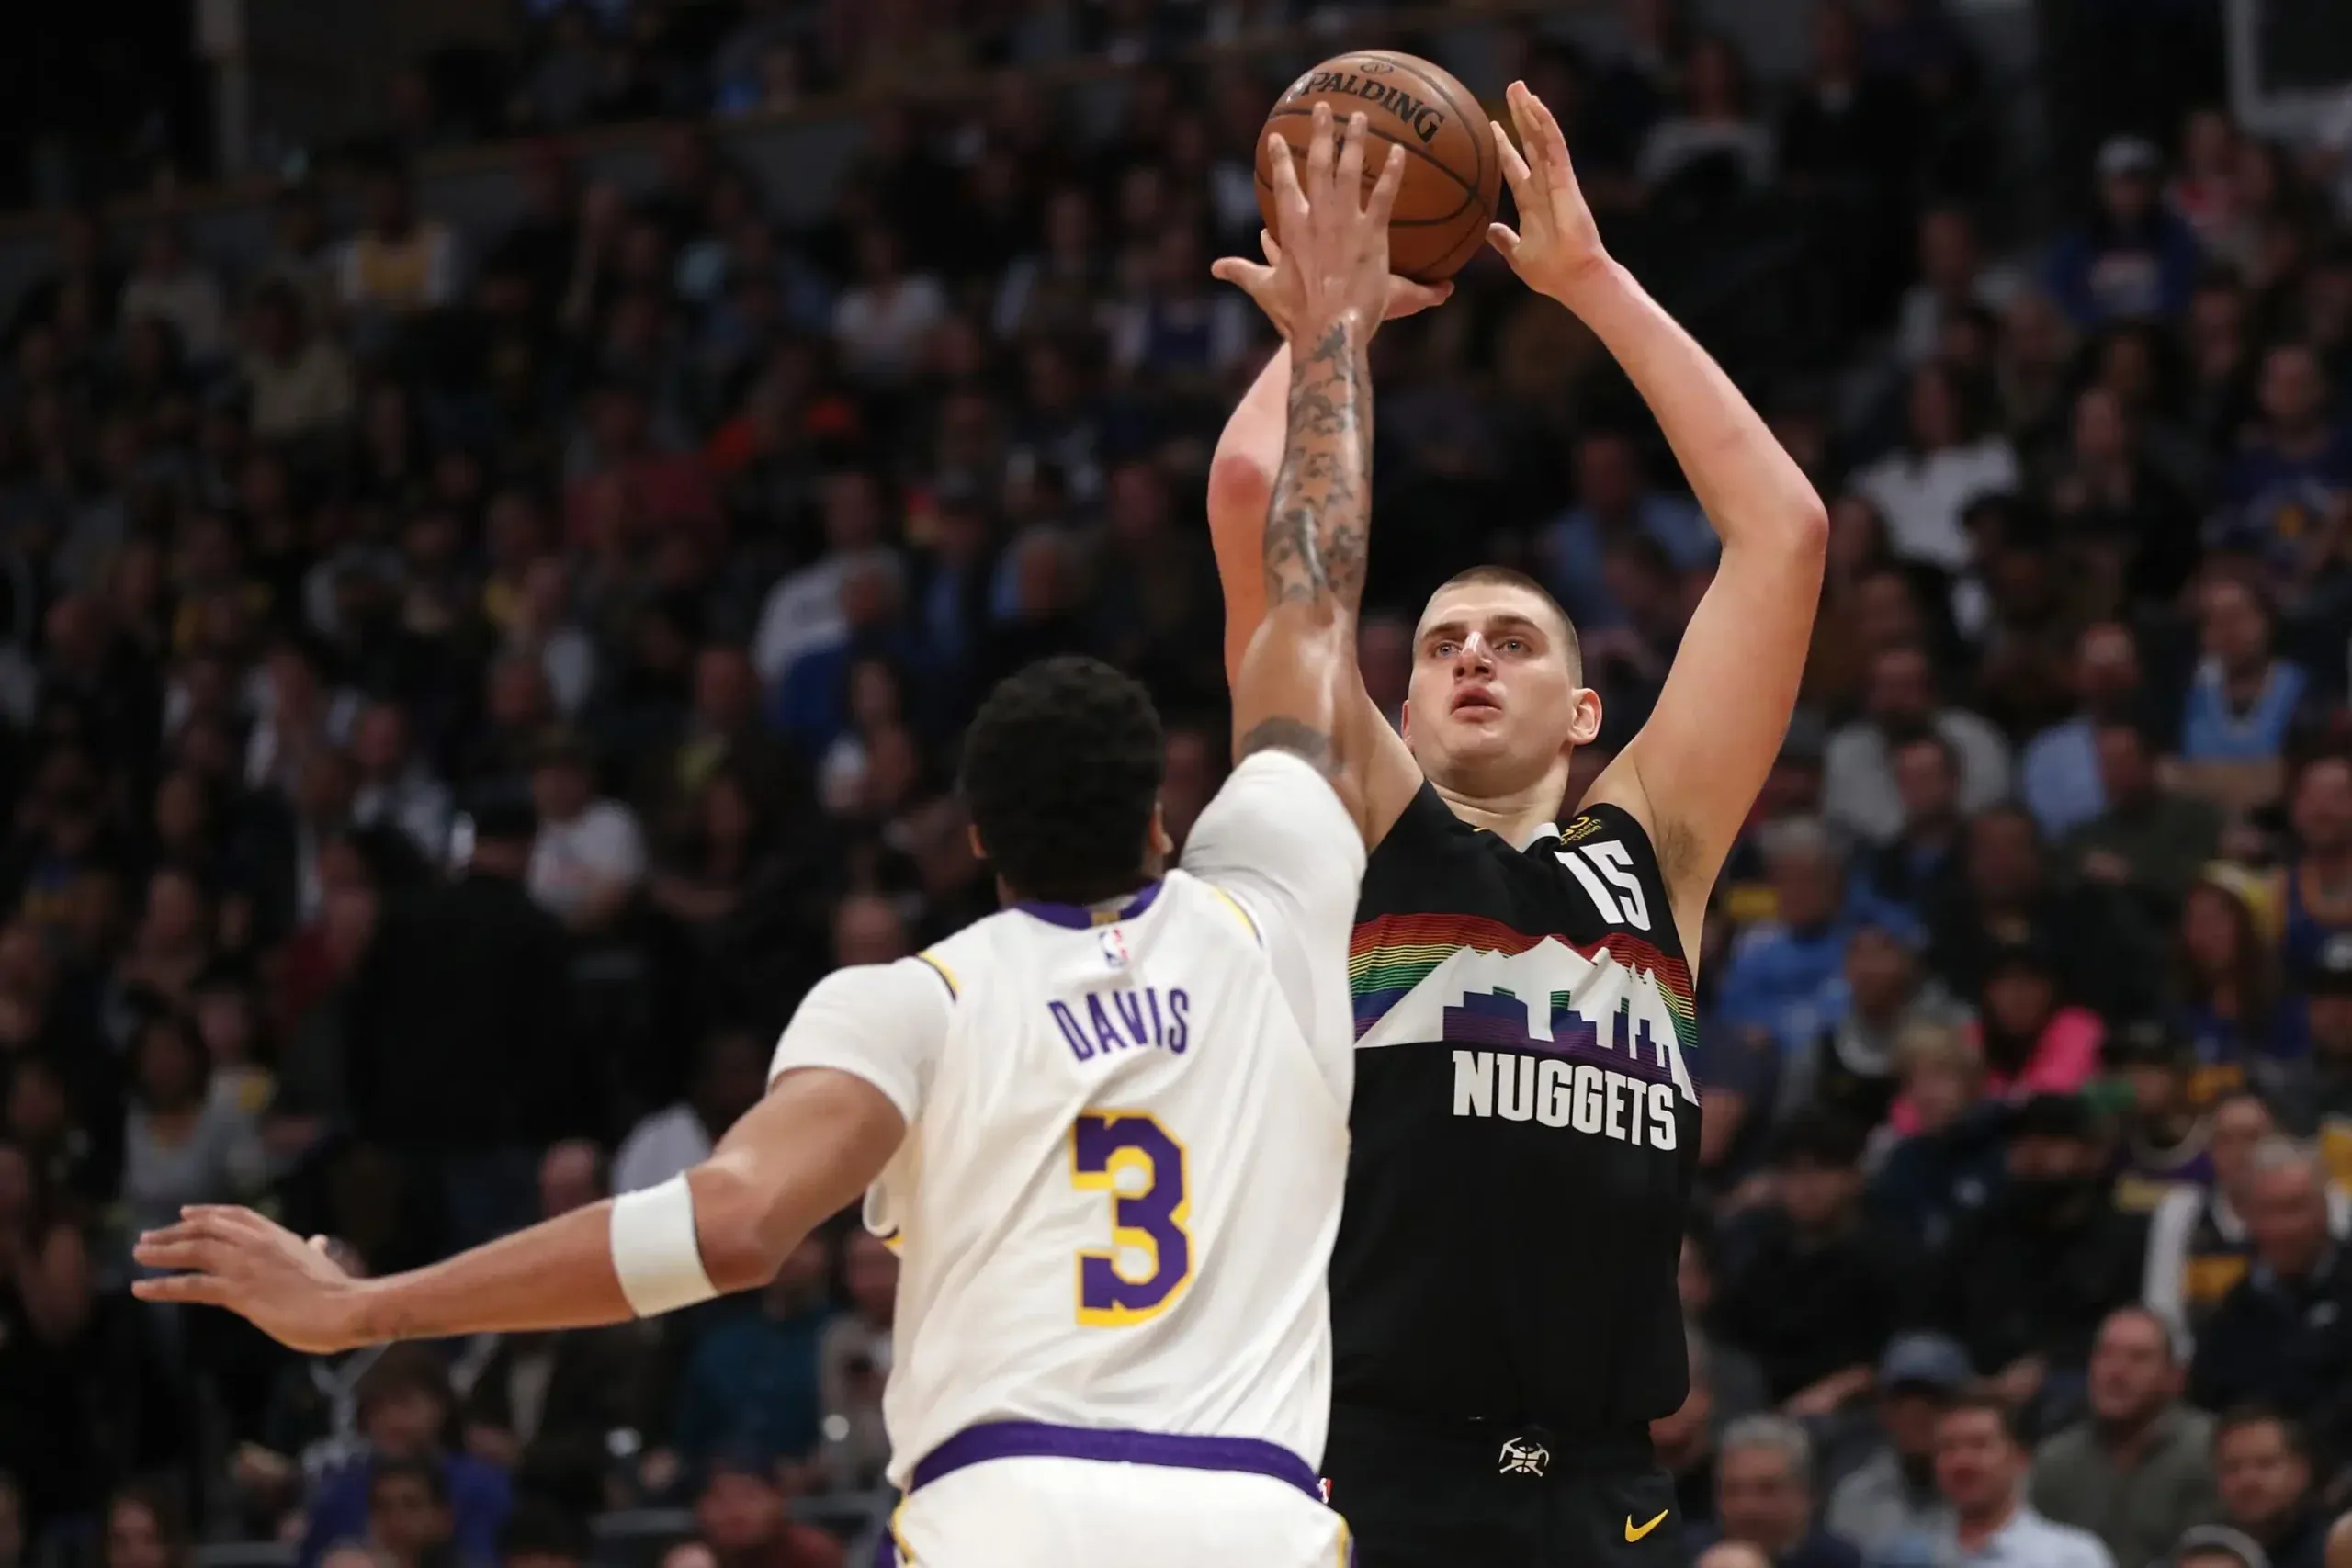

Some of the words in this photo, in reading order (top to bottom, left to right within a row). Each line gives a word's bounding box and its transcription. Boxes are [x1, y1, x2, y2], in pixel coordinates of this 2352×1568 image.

[1300, 72, 1446, 144] PALDING
[1554, 839, 1652, 931] 15
[1046, 987, 1190, 1062] DAVIS
[1452, 1049, 1678, 1152] NUGGETS
[1068, 1108, 1193, 1328] 3
